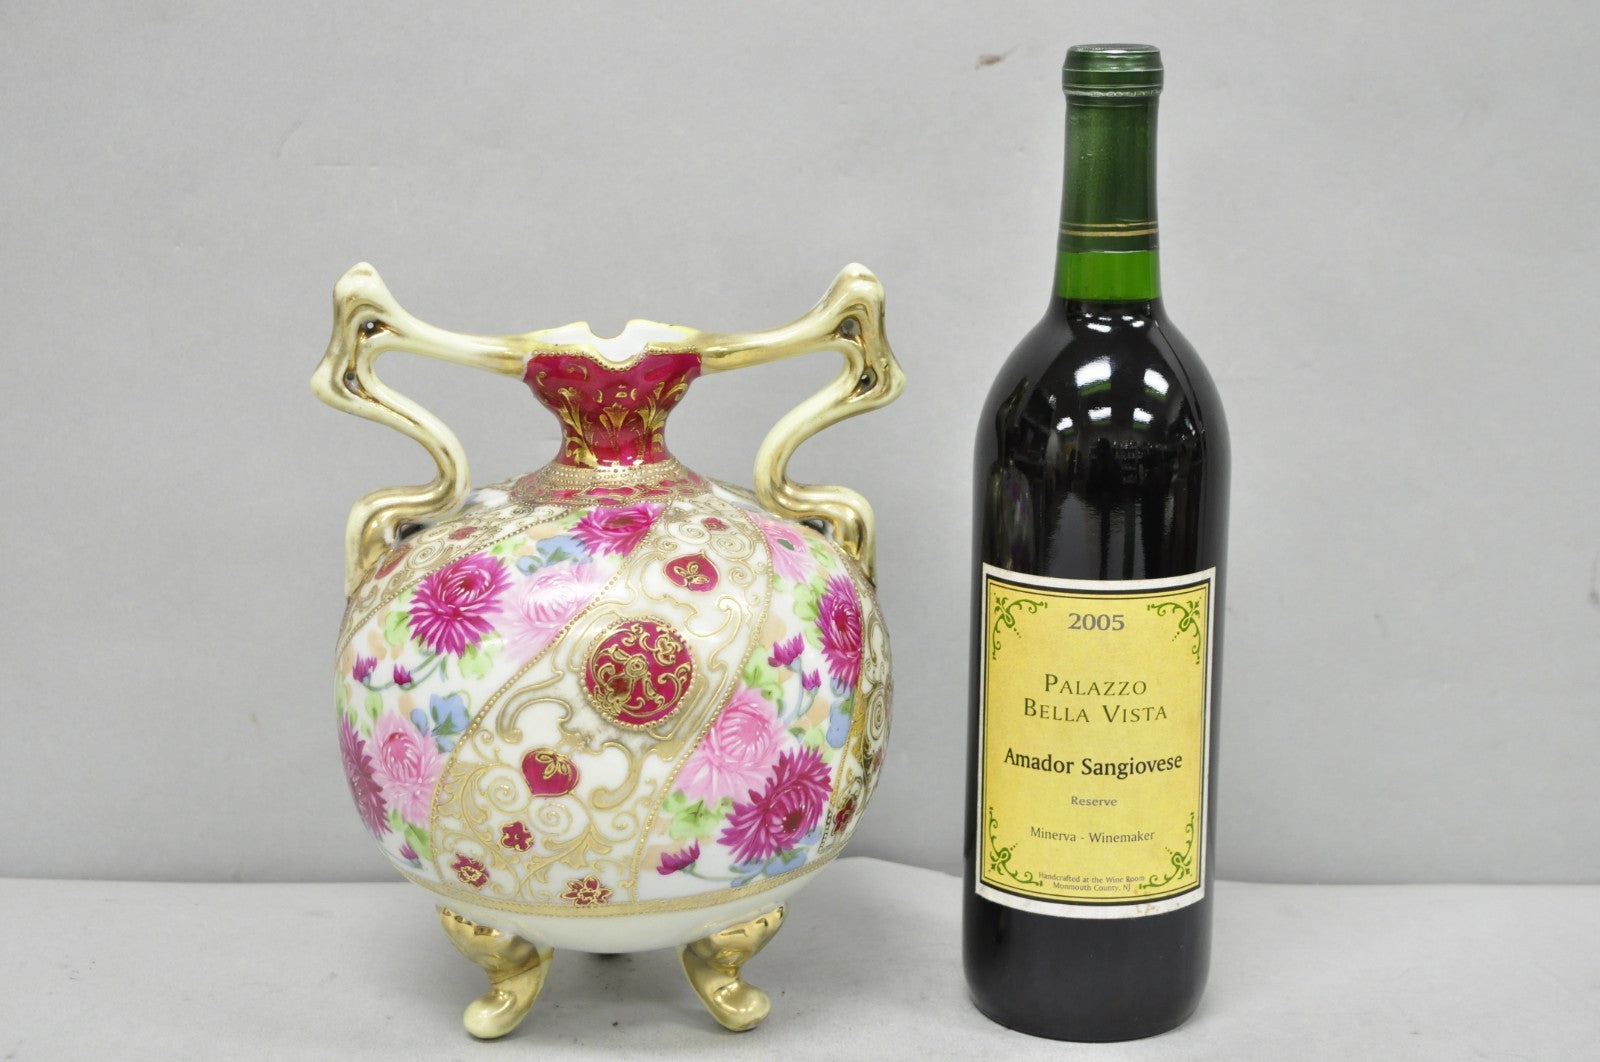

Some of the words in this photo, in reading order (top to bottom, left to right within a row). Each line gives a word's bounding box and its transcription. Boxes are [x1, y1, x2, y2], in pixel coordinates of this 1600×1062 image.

[1067, 612, 1125, 631] 2005
[1003, 747, 1075, 775] Amador
[1081, 754, 1183, 780] Sangiovese
[1070, 795, 1118, 807] Reserve
[1030, 825, 1077, 843] Minerva
[1088, 829, 1155, 844] Winemaker
[1038, 871, 1081, 883] Handcrafted
[1091, 876, 1103, 884] the
[1052, 881, 1092, 891] Monmouth
[1122, 883, 1131, 892] NJ
